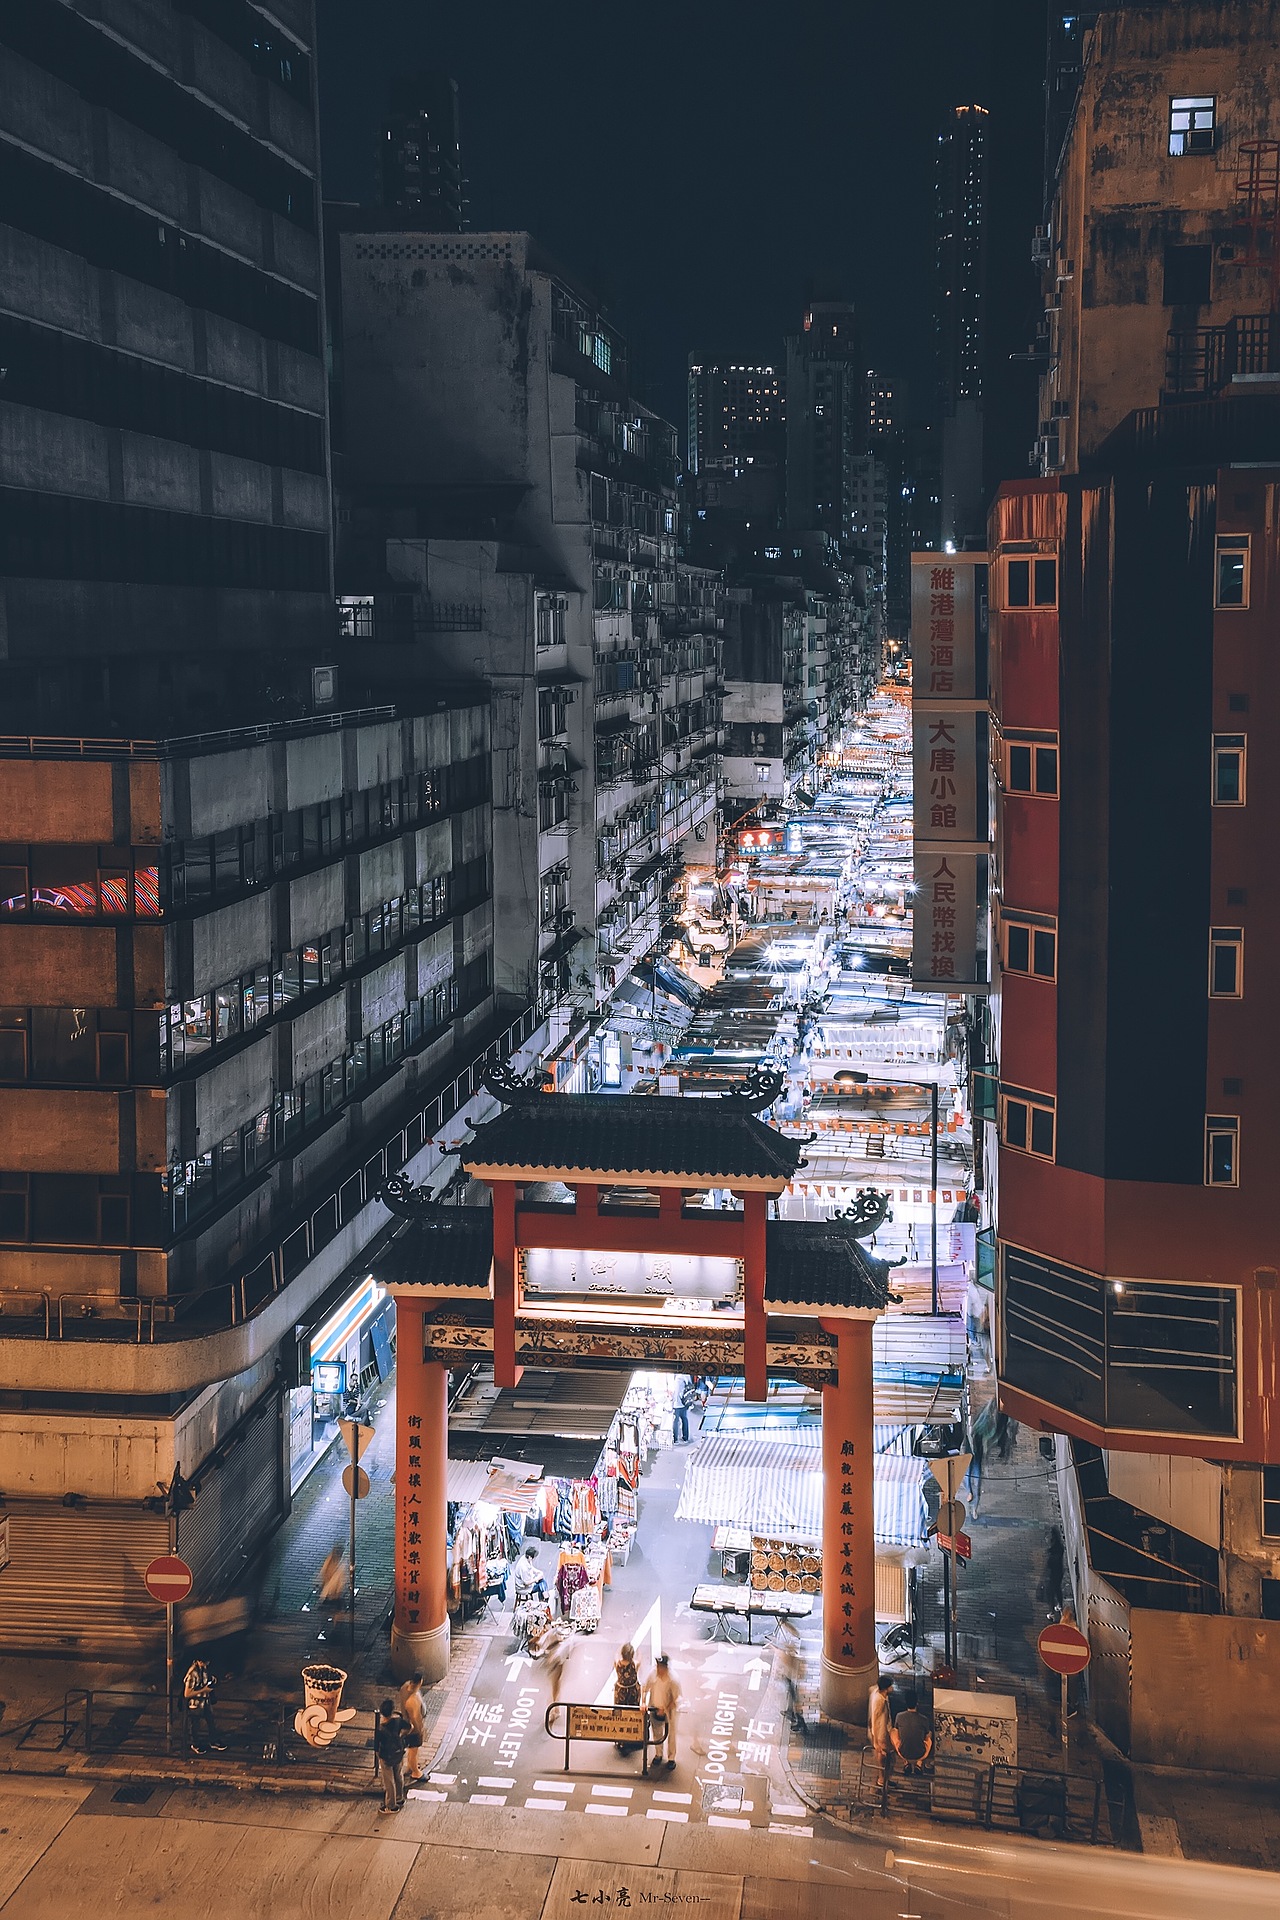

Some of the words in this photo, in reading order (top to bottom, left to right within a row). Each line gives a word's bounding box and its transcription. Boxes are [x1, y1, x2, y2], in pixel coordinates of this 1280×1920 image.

[930, 567, 955, 693] 維港灣酒店
[929, 719, 956, 829] 大唐小館
[931, 857, 956, 978] 人民幣找換
[588, 1283, 627, 1293] Temple
[644, 1286, 675, 1296] Street
[459, 1702, 505, 1747] 望左
[508, 1687, 540, 1730] LOOK
[711, 1691, 739, 1737] RIGHT
[493, 1732, 524, 1769] LEFT
[701, 1739, 732, 1786] LOOK
